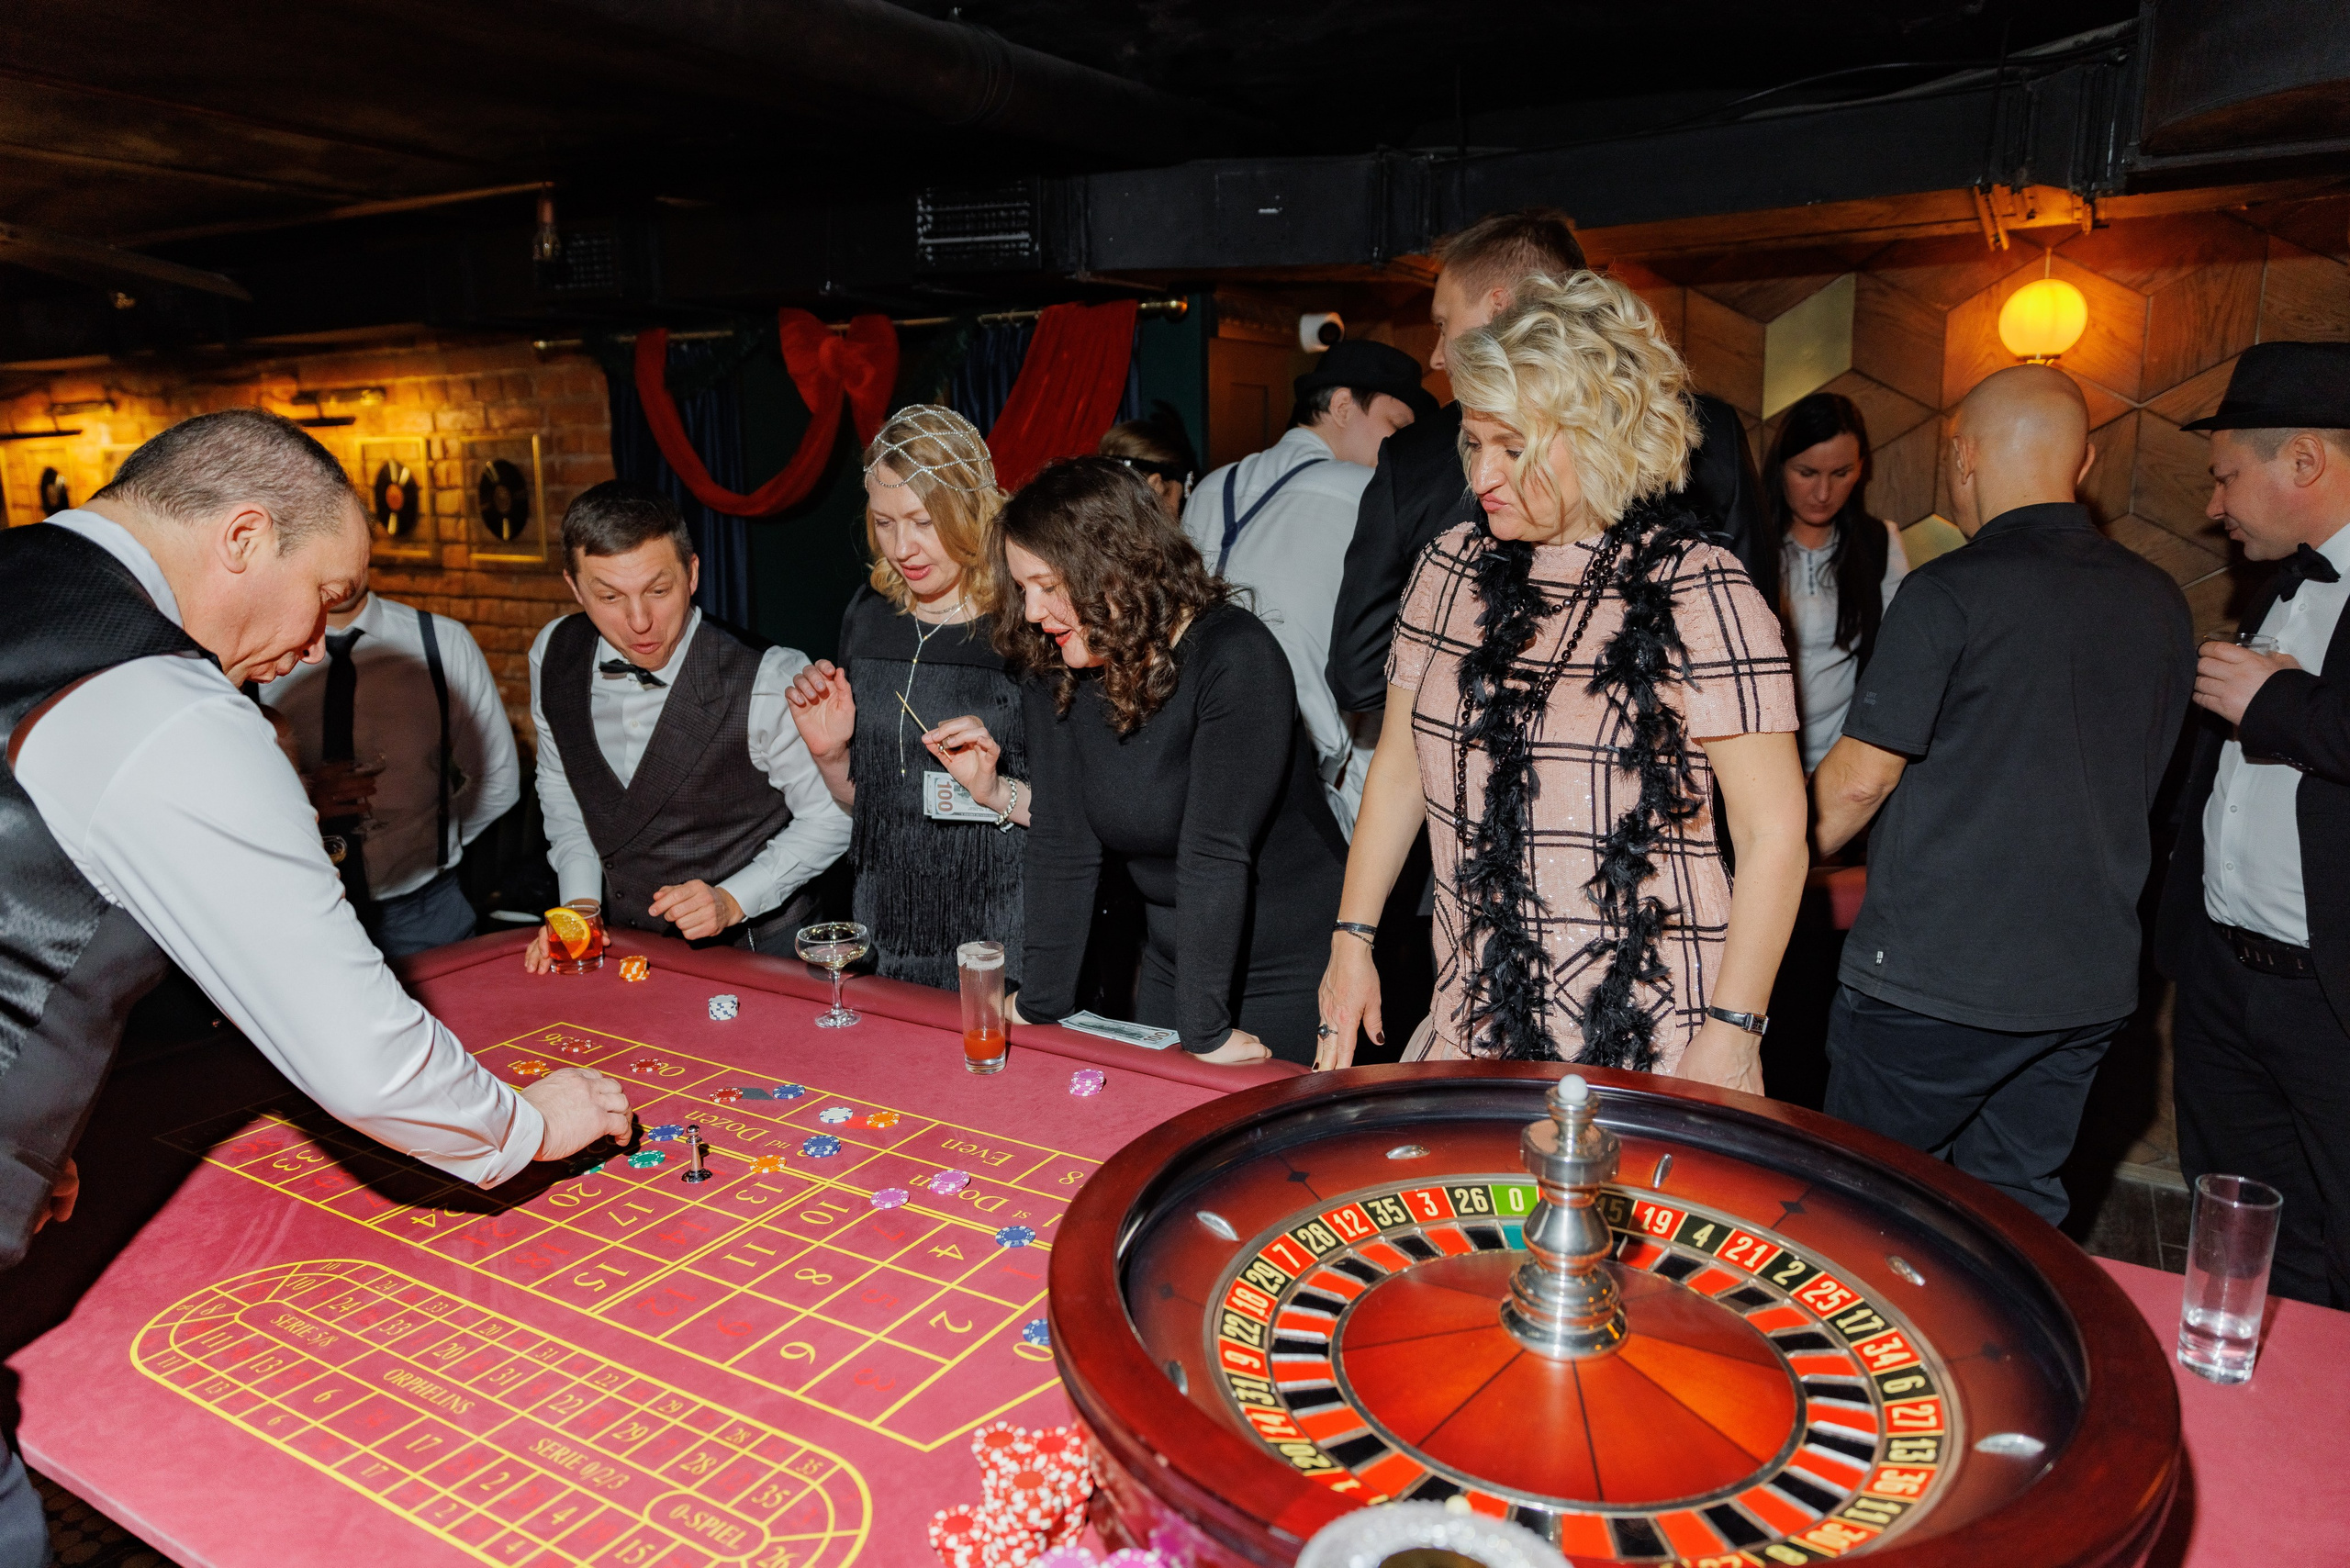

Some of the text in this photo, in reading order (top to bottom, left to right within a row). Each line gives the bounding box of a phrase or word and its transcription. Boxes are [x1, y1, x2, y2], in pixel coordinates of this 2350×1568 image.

[937, 781, 953, 812] 100
[684, 1110, 771, 1142] Dozen
[272, 1149, 324, 1171] 33
[941, 1138, 1015, 1167] Even
[549, 1182, 602, 1207] 20
[735, 1182, 784, 1204] 13
[909, 1174, 1010, 1213] Don
[1416, 1193, 1439, 1216] 3
[1454, 1188, 1489, 1214] 26
[1508, 1188, 1525, 1212] 0
[608, 1201, 655, 1226] 17
[800, 1201, 850, 1225] 10
[1333, 1209, 1370, 1238] 12
[1368, 1197, 1406, 1226] 35
[1640, 1206, 1673, 1235] 19
[460, 1221, 517, 1247] 21
[658, 1221, 710, 1245] 14
[872, 1226, 905, 1241] 7
[1296, 1223, 1337, 1254] 28
[1693, 1223, 1716, 1249] 4
[515, 1243, 569, 1269] 18
[722, 1242, 777, 1267] 11
[927, 1243, 964, 1260] 4
[1272, 1243, 1300, 1269] 7
[1725, 1236, 1768, 1269] 21
[286, 1276, 316, 1291] 10
[574, 1262, 630, 1293] 15
[794, 1268, 833, 1285] 8
[1246, 1261, 1285, 1294] 29
[1773, 1260, 1807, 1285] 2
[375, 1280, 398, 1291] 24
[1802, 1281, 1852, 1311] 25
[200, 1304, 226, 1315] 8
[329, 1296, 362, 1313] 24
[426, 1302, 448, 1313] 33
[637, 1287, 697, 1316] 12
[861, 1289, 899, 1308] 5
[1231, 1287, 1269, 1316] 18
[270, 1314, 316, 1341] SERIE
[379, 1319, 411, 1335] 33
[479, 1324, 502, 1336] 20
[929, 1311, 973, 1333] 2
[1223, 1314, 1261, 1346] 22
[1836, 1309, 1886, 1334] 17
[201, 1332, 233, 1348] 11
[431, 1342, 466, 1361] 20
[1013, 1341, 1054, 1362] 0
[158, 1356, 182, 1368] 11
[536, 1348, 558, 1361] 31
[1225, 1350, 1261, 1370] 9
[1863, 1337, 1911, 1368] 34
[250, 1357, 283, 1373] 13
[489, 1368, 523, 1386] 31
[383, 1368, 476, 1414] ORPHELINS
[594, 1373, 619, 1387] 22
[854, 1368, 896, 1392] 3
[1230, 1377, 1275, 1406] 31
[1883, 1375, 1926, 1394] 6
[313, 1389, 343, 1403] 6
[547, 1394, 584, 1415] 22
[657, 1399, 684, 1414] 29
[268, 1415, 288, 1426] 6
[1250, 1412, 1298, 1436] 14
[1892, 1405, 1937, 1428] 27
[611, 1421, 650, 1442] 29
[725, 1428, 753, 1444] 28
[405, 1434, 444, 1454] 17
[529, 1438, 589, 1471] SERIE
[1279, 1443, 1331, 1469] 20
[1888, 1438, 1937, 1462] 13
[361, 1462, 389, 1478] 17
[679, 1452, 718, 1476] 28
[795, 1458, 824, 1475] 35
[479, 1471, 510, 1491] 2
[1873, 1469, 1928, 1495] 36
[751, 1484, 791, 1509] 35
[434, 1504, 457, 1518] 2
[551, 1506, 578, 1526] 4
[1843, 1498, 1902, 1524] 11
[668, 1504, 747, 1551] 0-SPIEL
[505, 1540, 527, 1554] 4
[614, 1539, 655, 1564] 15
